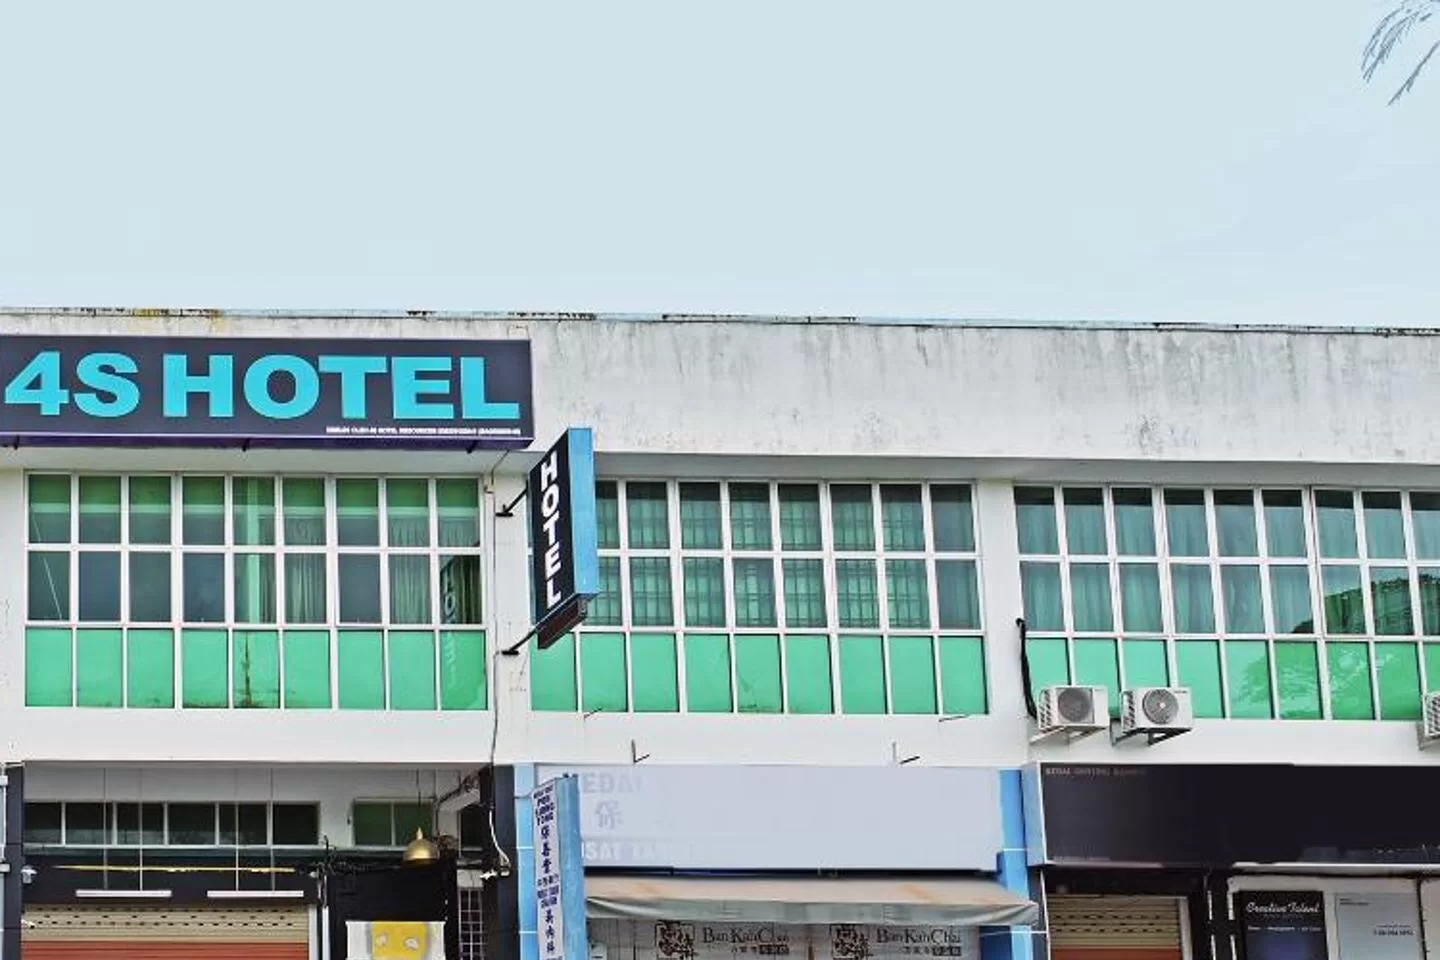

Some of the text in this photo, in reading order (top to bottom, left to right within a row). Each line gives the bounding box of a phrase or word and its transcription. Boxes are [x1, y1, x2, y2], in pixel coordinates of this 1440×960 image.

[3, 350, 521, 420] 4S HOTEL
[539, 452, 562, 606] HOTEL
[1245, 901, 1321, 914] Creative Talent
